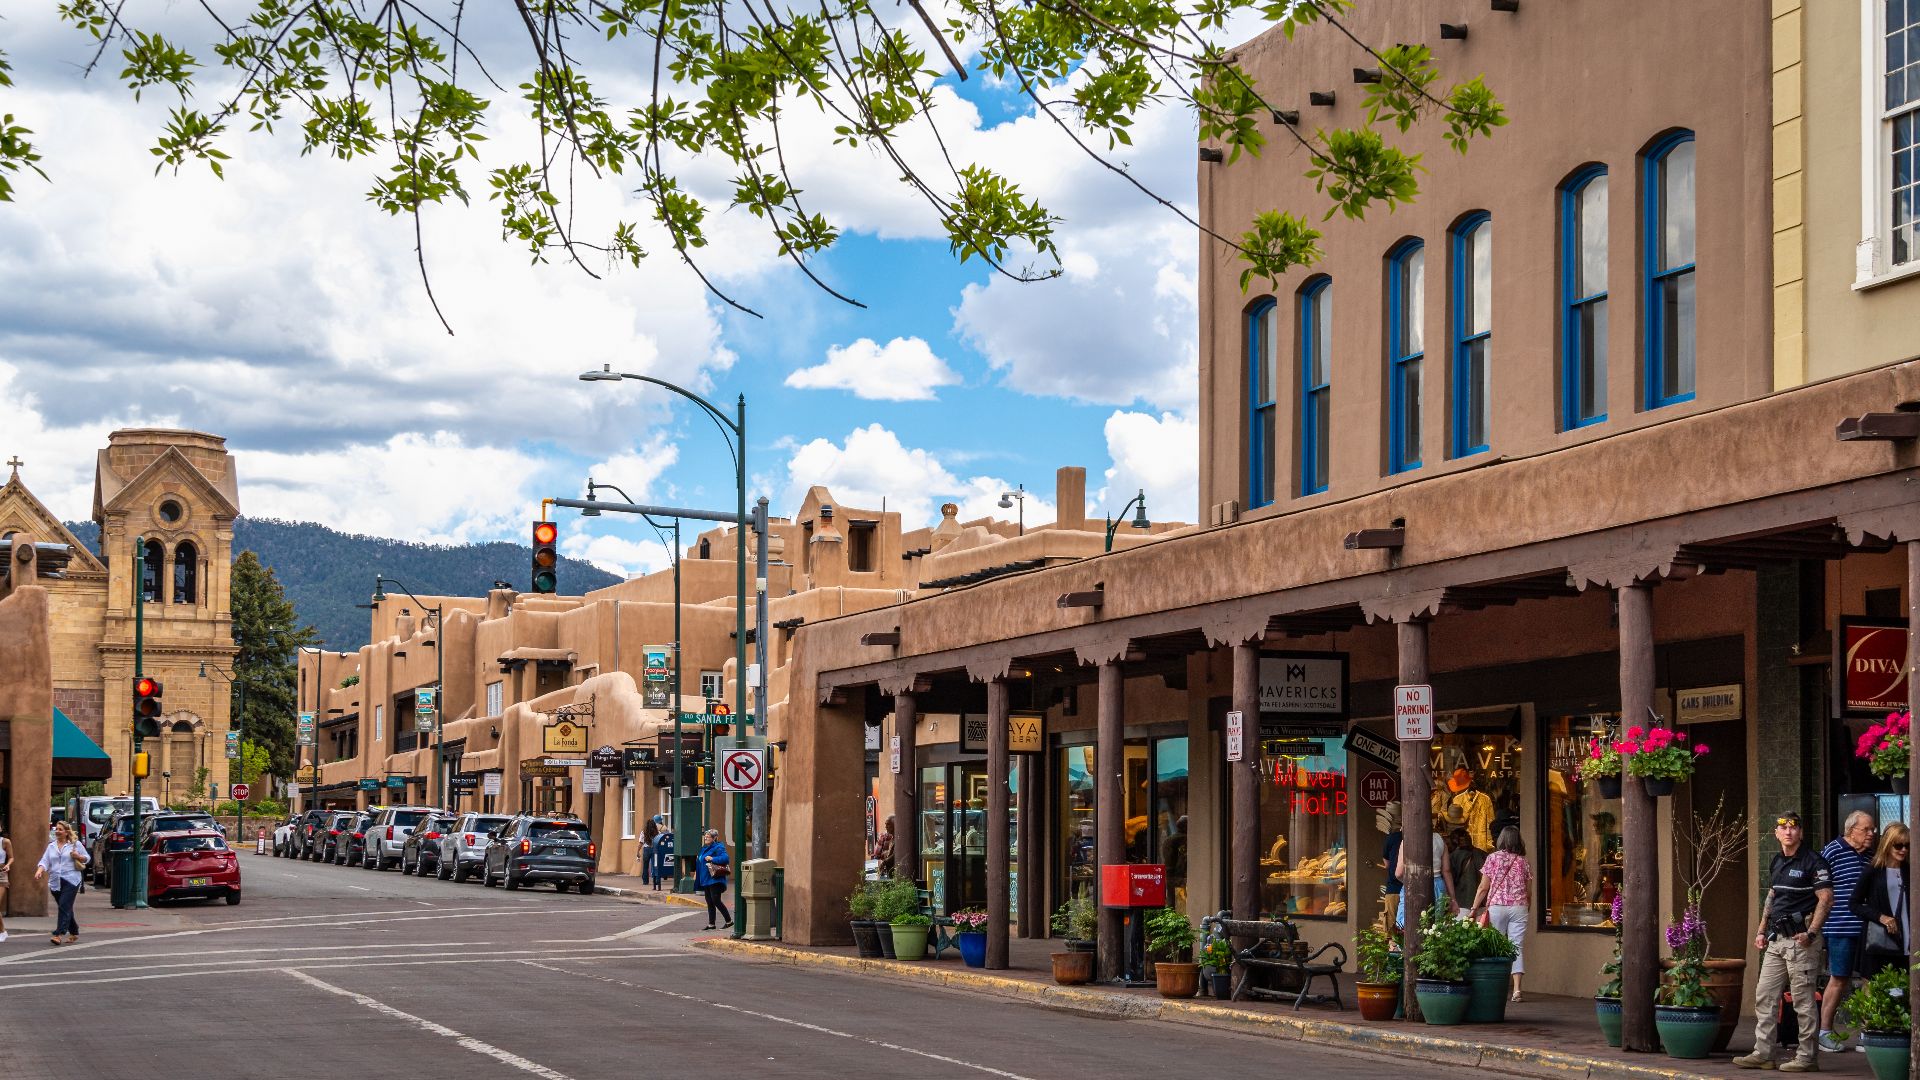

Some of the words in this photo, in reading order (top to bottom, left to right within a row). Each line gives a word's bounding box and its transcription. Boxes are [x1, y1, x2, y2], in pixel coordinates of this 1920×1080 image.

[1855, 658, 1900, 674] DIVA
[1406, 690, 1420, 701] NO
[1702, 693, 1734, 708] BUILDING
[1398, 704, 1430, 716] PARKING
[695, 714, 722, 724] SANTA
[725, 714, 735, 724] FE
[1407, 717, 1420, 725] ANY
[1273, 727, 1280, 735] &
[1406, 727, 1422, 735] TIME
[1275, 743, 1317, 753] Furniture
[1356, 736, 1377, 753] ONE
[1379, 746, 1400, 764] WAY
[1369, 778, 1388, 790] HAT
[233, 788, 248, 796] STOP
[1369, 790, 1388, 801] BAR
